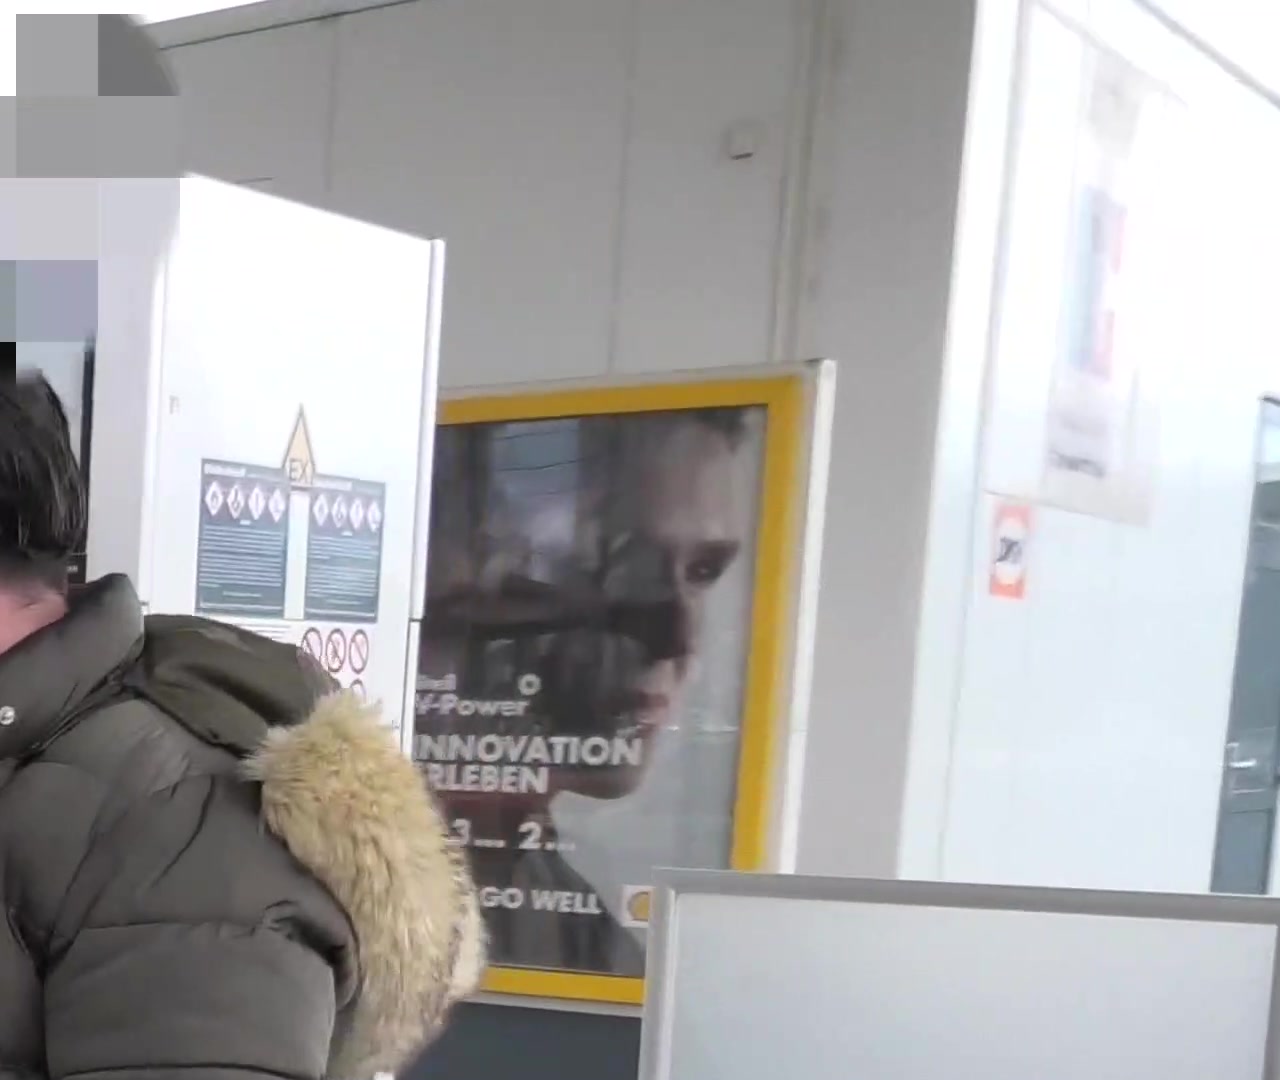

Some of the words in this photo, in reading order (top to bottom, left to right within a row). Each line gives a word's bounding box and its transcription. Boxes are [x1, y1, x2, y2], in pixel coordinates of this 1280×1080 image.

[413, 733, 642, 766] INNOVATION
[426, 762, 550, 794] RLEBEN
[480, 886, 525, 909] GO
[530, 889, 603, 915] WELL
